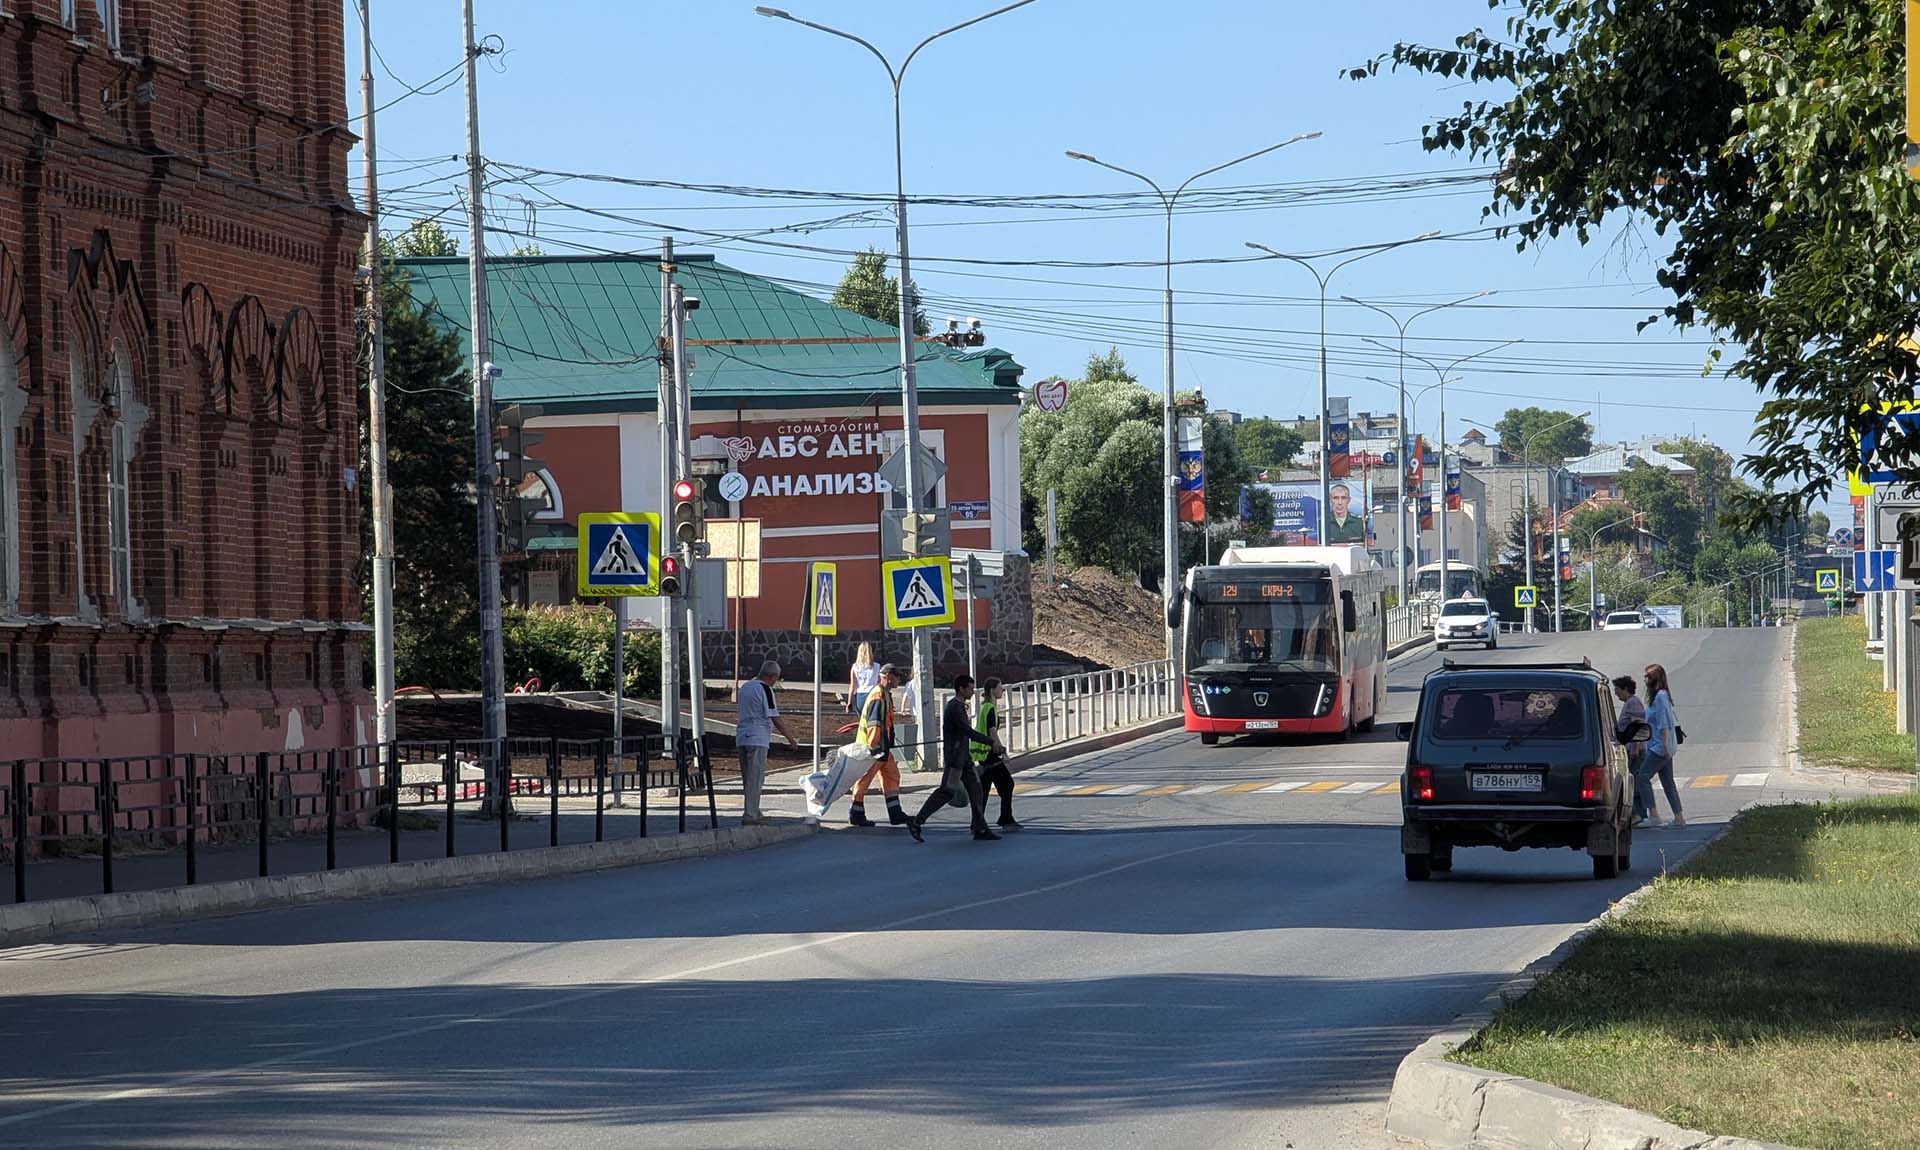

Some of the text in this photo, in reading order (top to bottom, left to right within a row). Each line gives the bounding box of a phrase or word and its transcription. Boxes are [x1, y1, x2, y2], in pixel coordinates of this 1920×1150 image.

[777, 422, 880, 435] СТОМАТОЛОГИЯ
[757, 434, 819, 459] АБС
[1409, 457, 1420, 475] 9
[1262, 584, 1293, 597] СКРУ-2
[1476, 775, 1540, 787] В786НУ 159
